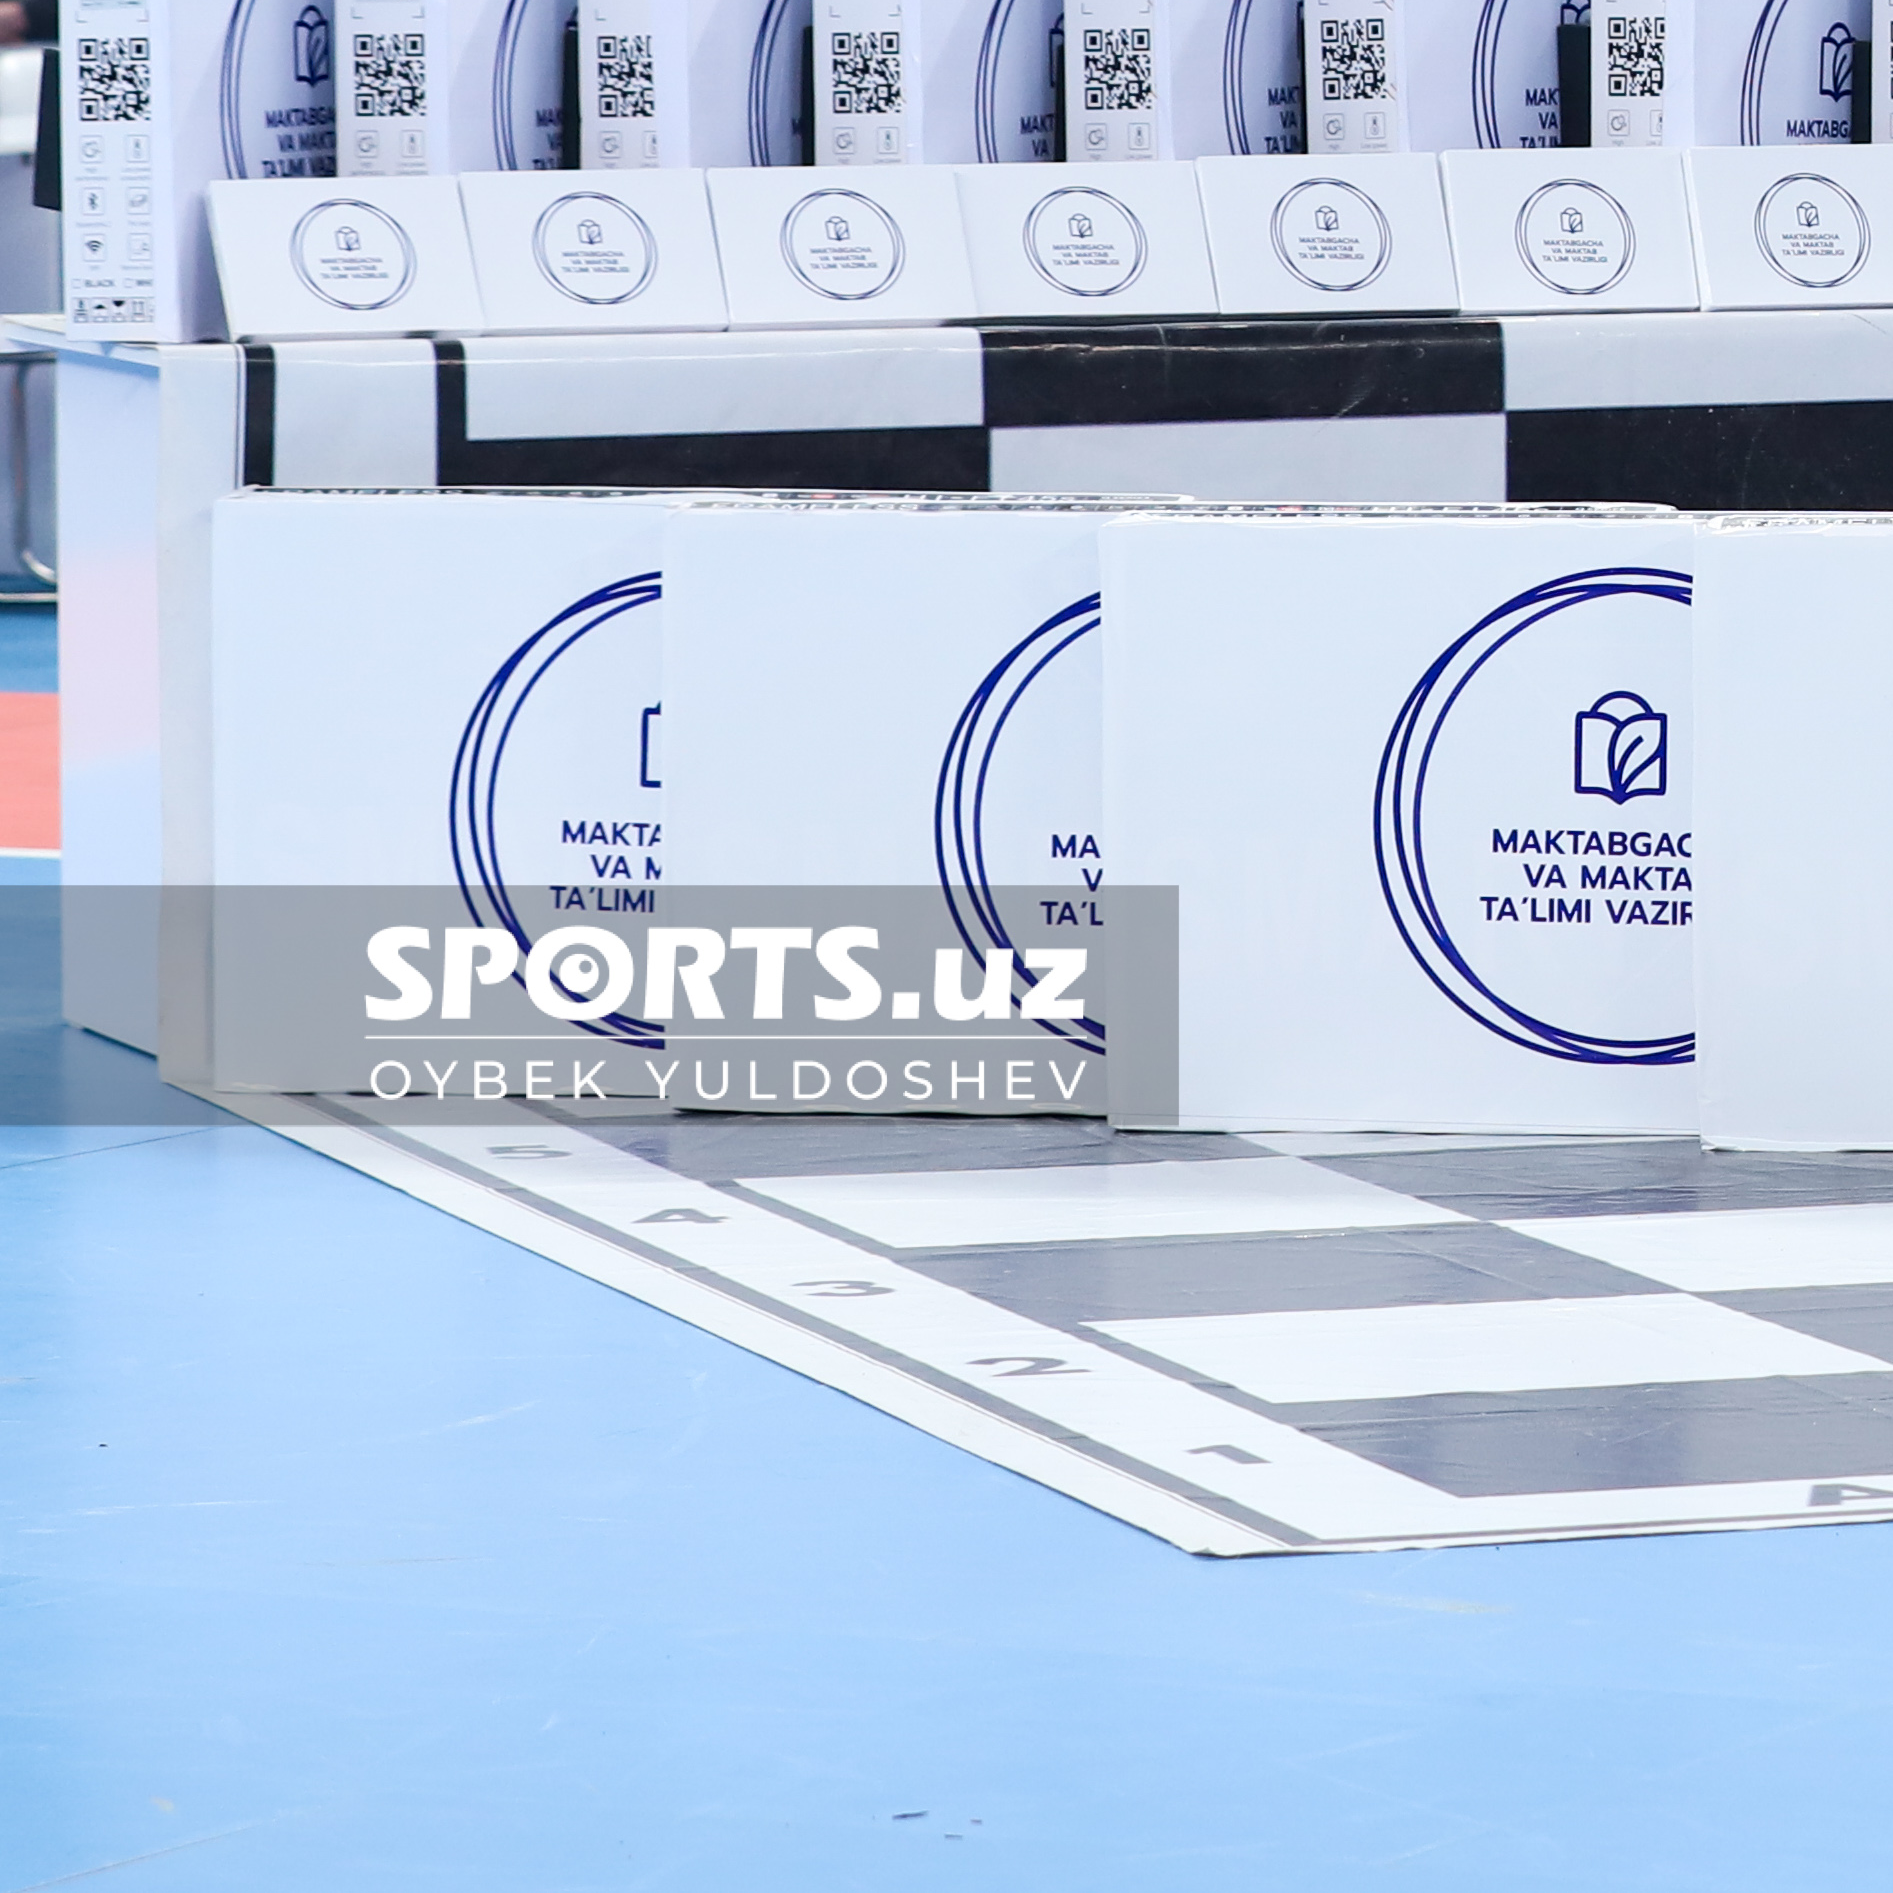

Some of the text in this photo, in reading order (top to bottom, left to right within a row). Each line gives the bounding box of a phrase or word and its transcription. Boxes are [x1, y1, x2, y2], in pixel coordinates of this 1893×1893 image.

[591, 855, 631, 879] VA
[1523, 864, 1566, 888] VA
[1480, 897, 1590, 923] TA'LIMI
[789, 1279, 897, 1298] 3
[967, 1354, 1091, 1378] 2
[1185, 1443, 1272, 1465] 1
